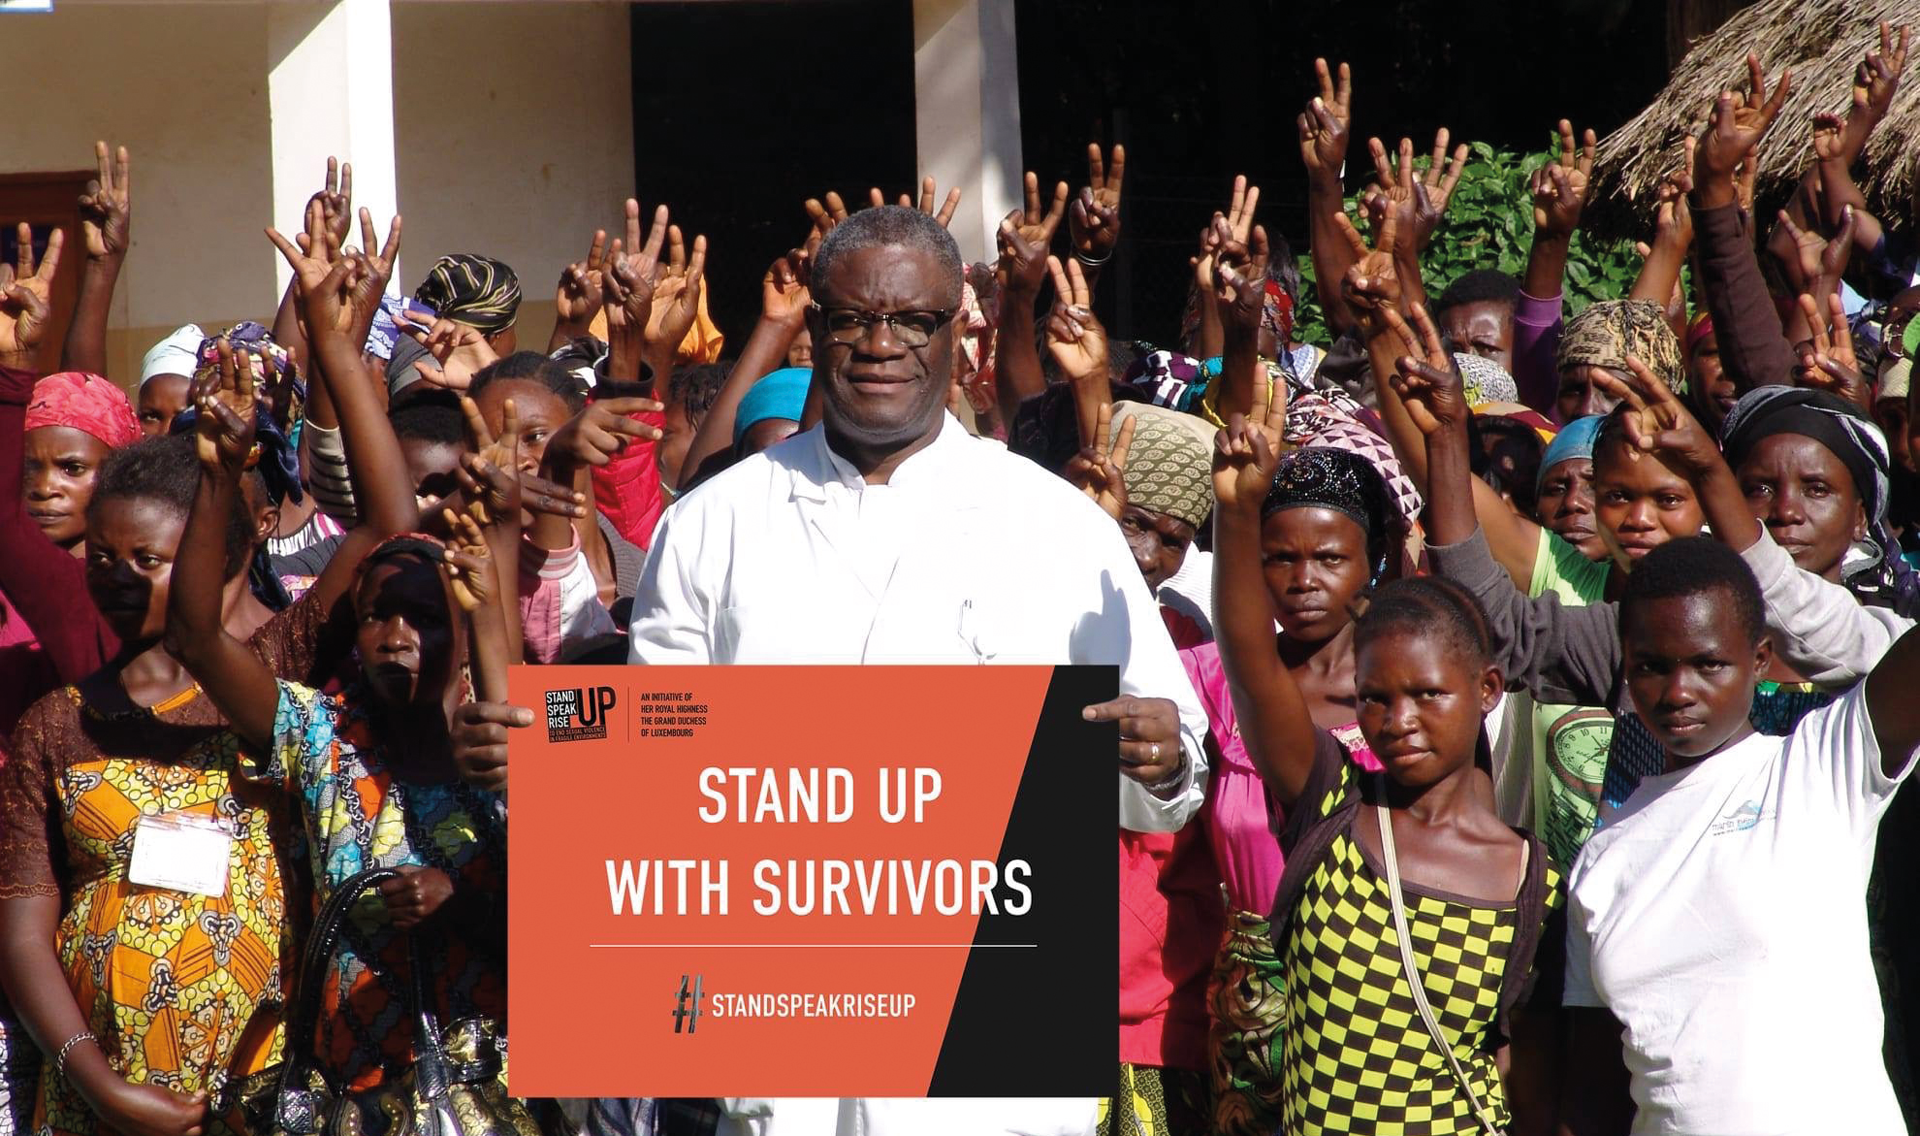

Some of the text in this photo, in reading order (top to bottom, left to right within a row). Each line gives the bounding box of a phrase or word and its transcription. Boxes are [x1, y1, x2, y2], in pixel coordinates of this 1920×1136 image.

[546, 690, 575, 704] STAND
[641, 692, 693, 701] AN INITIATIVE OF
[547, 703, 577, 716] SPEAK
[576, 686, 617, 727] UP
[641, 704, 708, 714] HER ROYAL HIGHNESS
[548, 716, 570, 729] RISE
[641, 716, 707, 726] THE GRAND DUCHESS
[641, 728, 694, 737] OF LUXEMBOURG
[698, 767, 943, 824] STAND UP
[605, 859, 1033, 916] WITH SURVIVORS
